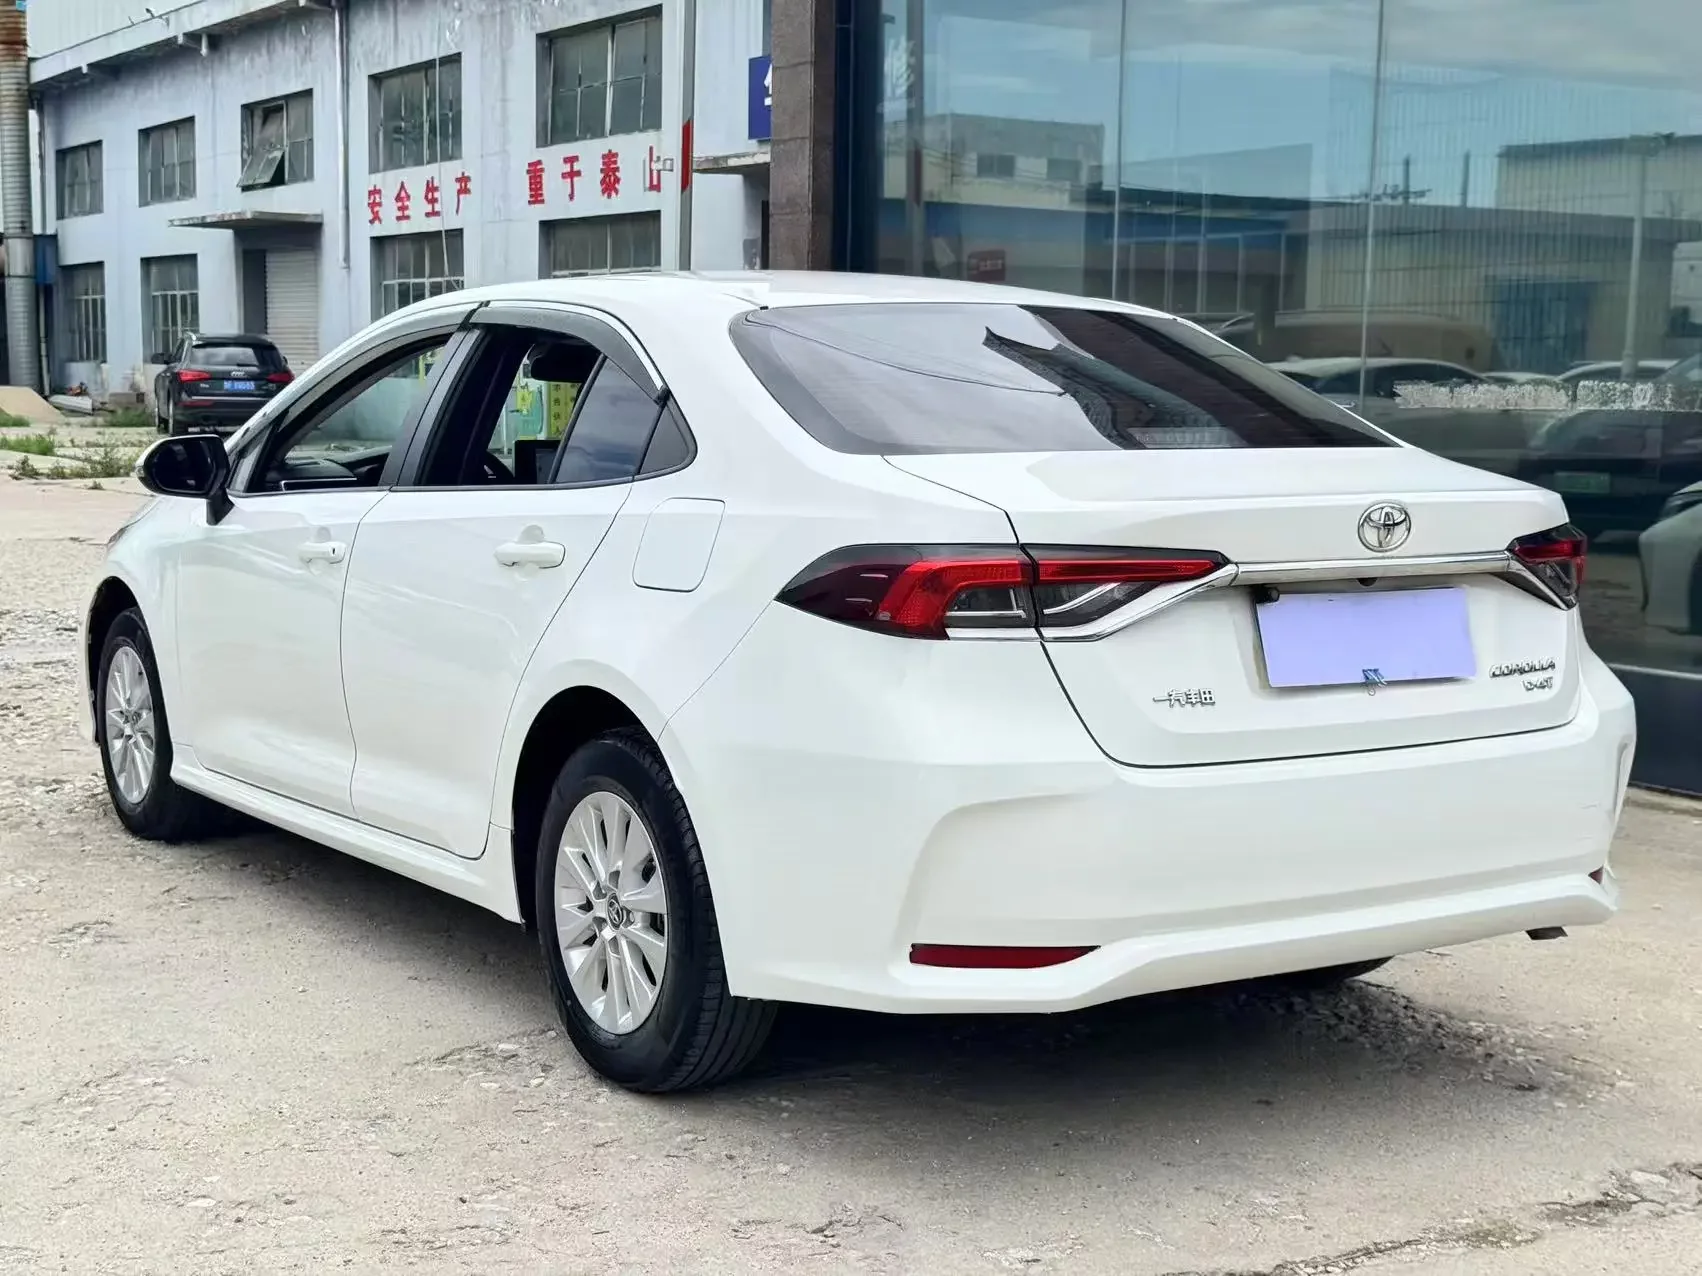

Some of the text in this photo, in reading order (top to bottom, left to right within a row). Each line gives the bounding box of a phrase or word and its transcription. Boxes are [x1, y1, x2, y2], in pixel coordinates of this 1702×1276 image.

[368, 145, 662, 225] 安全生产 重于泰山
[1489, 658, 1556, 678] COROLLA
[1152, 688, 1216, 709] 一汽丰田
